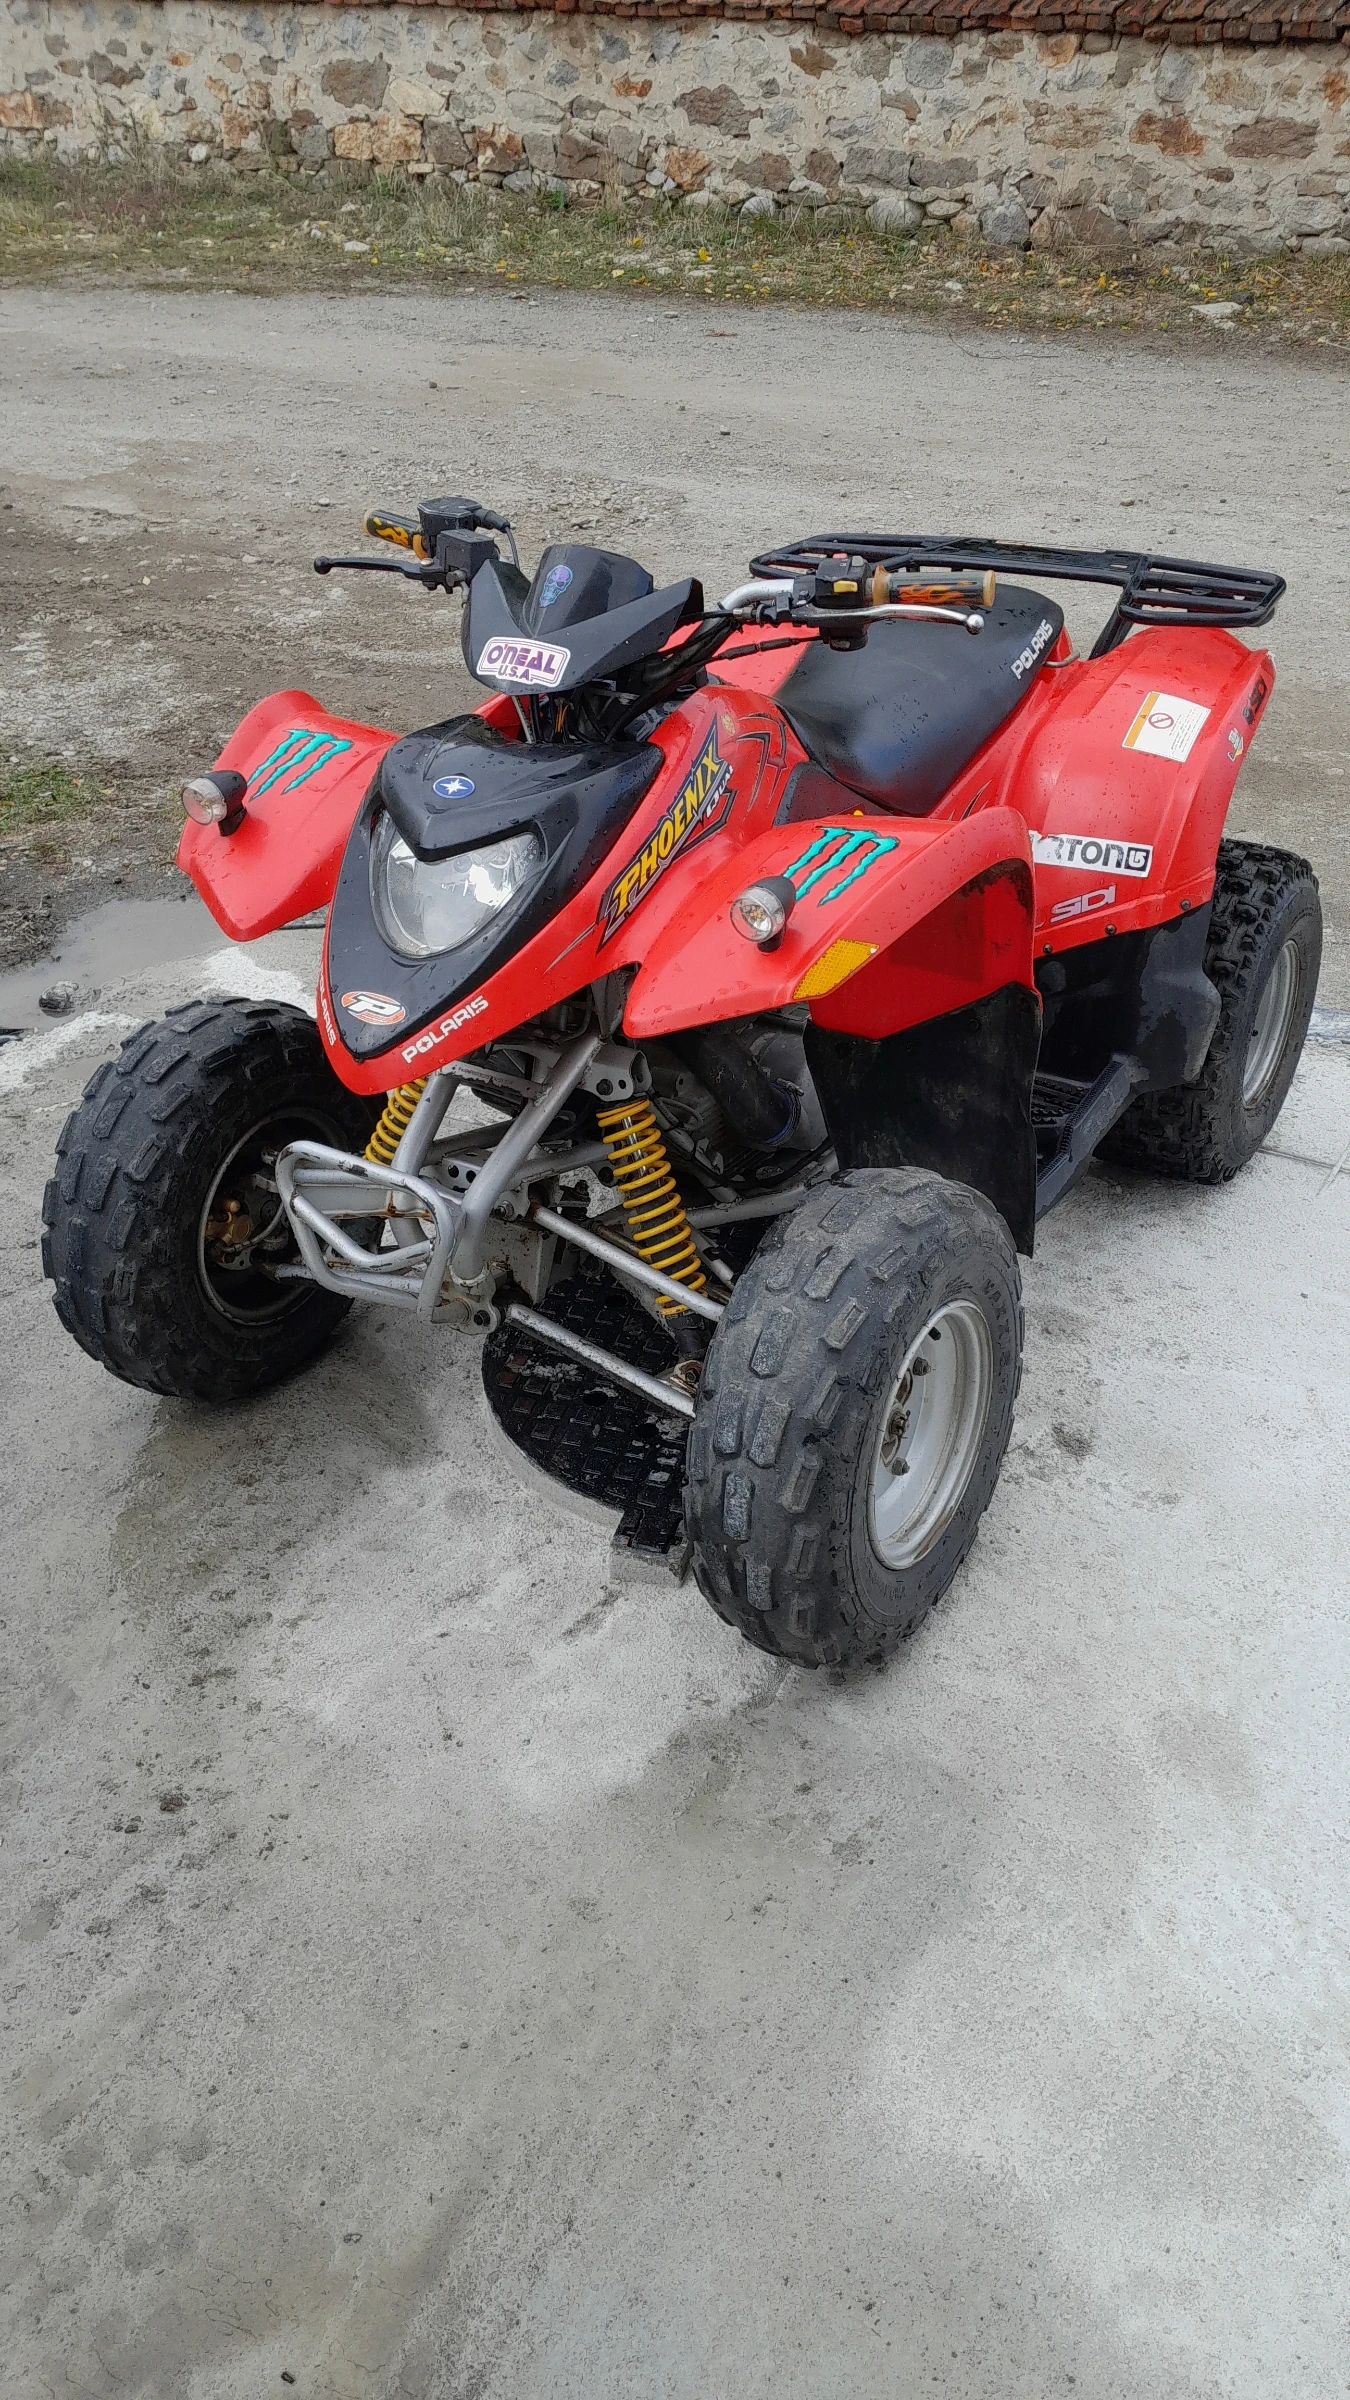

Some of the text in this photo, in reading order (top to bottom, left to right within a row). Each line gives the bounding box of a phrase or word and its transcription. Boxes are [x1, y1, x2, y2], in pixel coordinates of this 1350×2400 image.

[487, 643, 556, 675] O'NEAL
[498, 664, 534, 682] U.S.A.
[1010, 618, 1054, 680] POLARIS
[613, 742, 721, 916] PHOENIX
[401, 995, 489, 1064] POLARIS
